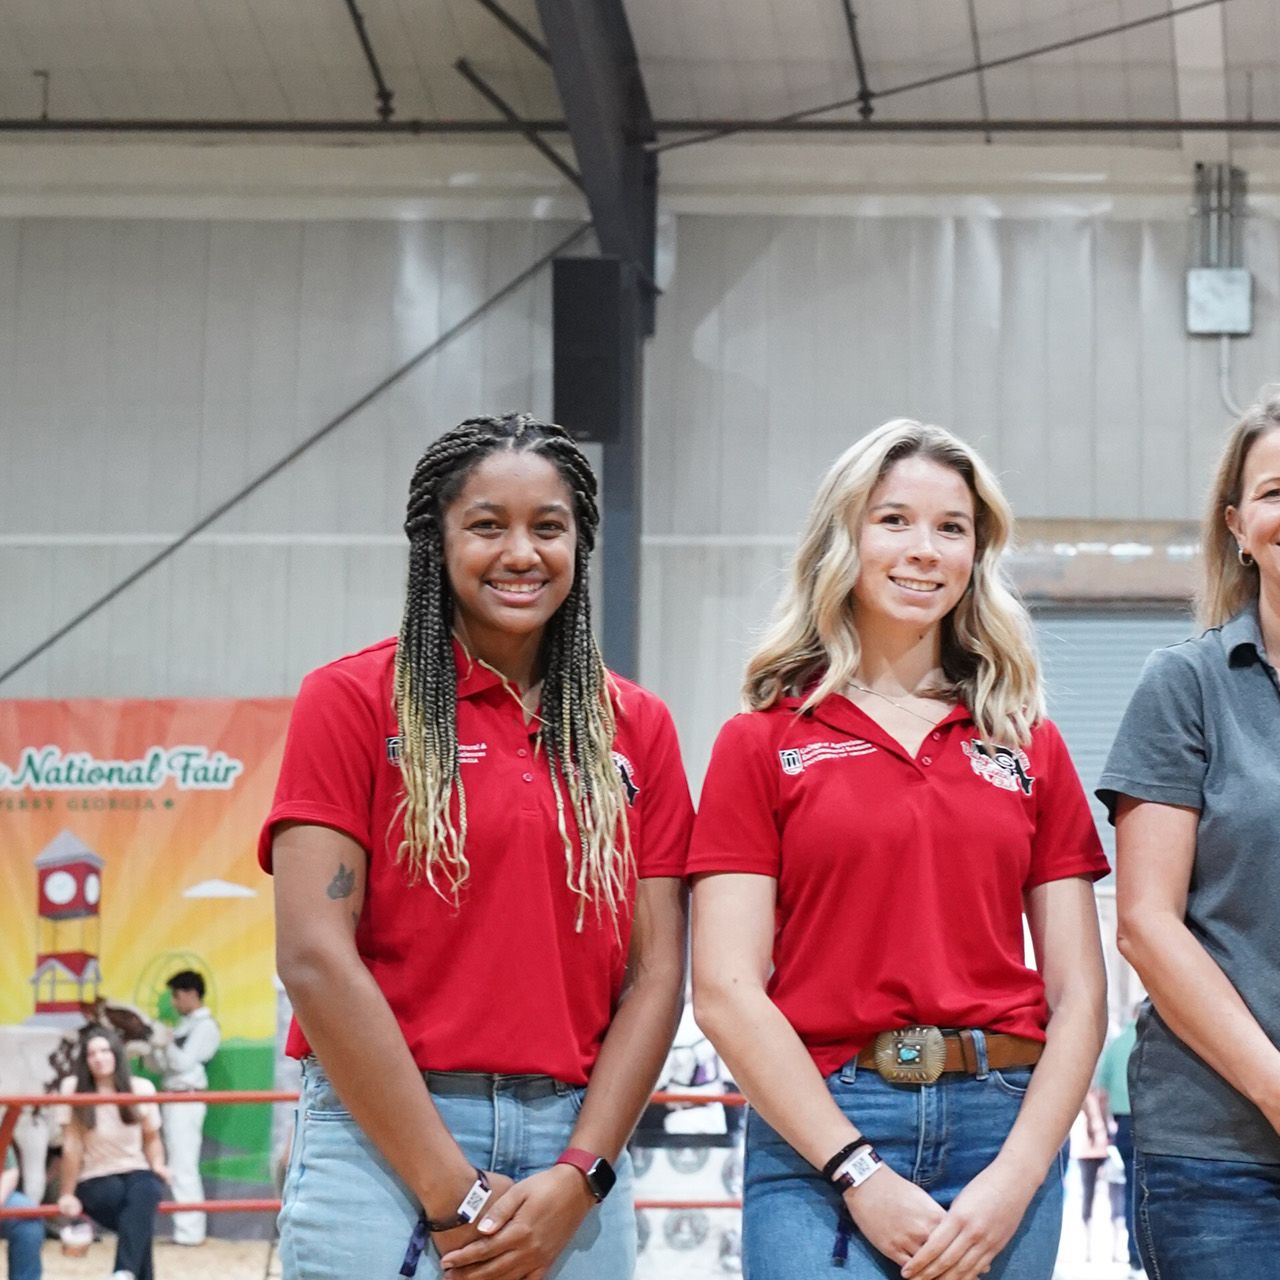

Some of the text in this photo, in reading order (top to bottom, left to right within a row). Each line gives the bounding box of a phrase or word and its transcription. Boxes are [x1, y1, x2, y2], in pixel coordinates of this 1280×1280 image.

[10, 749, 238, 786] National Fair
[0, 796, 55, 812] ERRY
